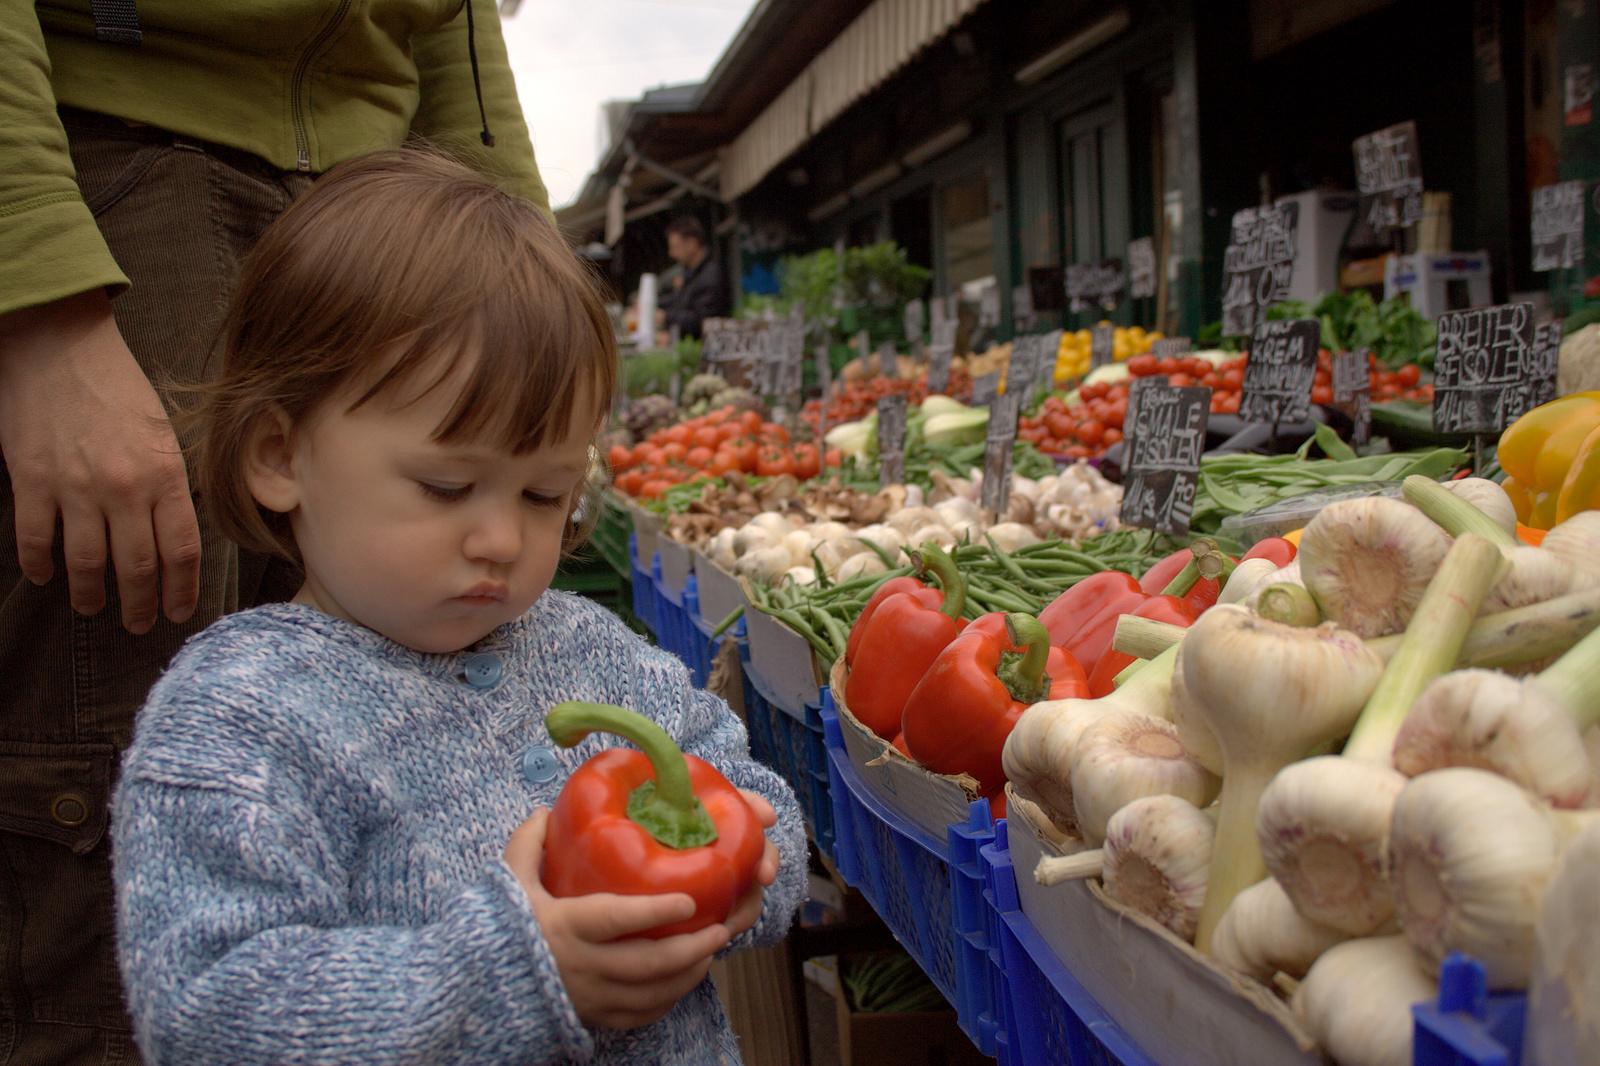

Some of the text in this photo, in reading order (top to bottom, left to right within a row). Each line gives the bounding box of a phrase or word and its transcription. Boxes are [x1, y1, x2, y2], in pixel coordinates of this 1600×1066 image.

[1438, 306, 1526, 355] BREITER
[1250, 335, 1304, 365] KREM
[1445, 346, 1531, 387] FISOLEN
[1136, 402, 1203, 438] SMALE
[1133, 432, 1203, 466] FISOLEN
